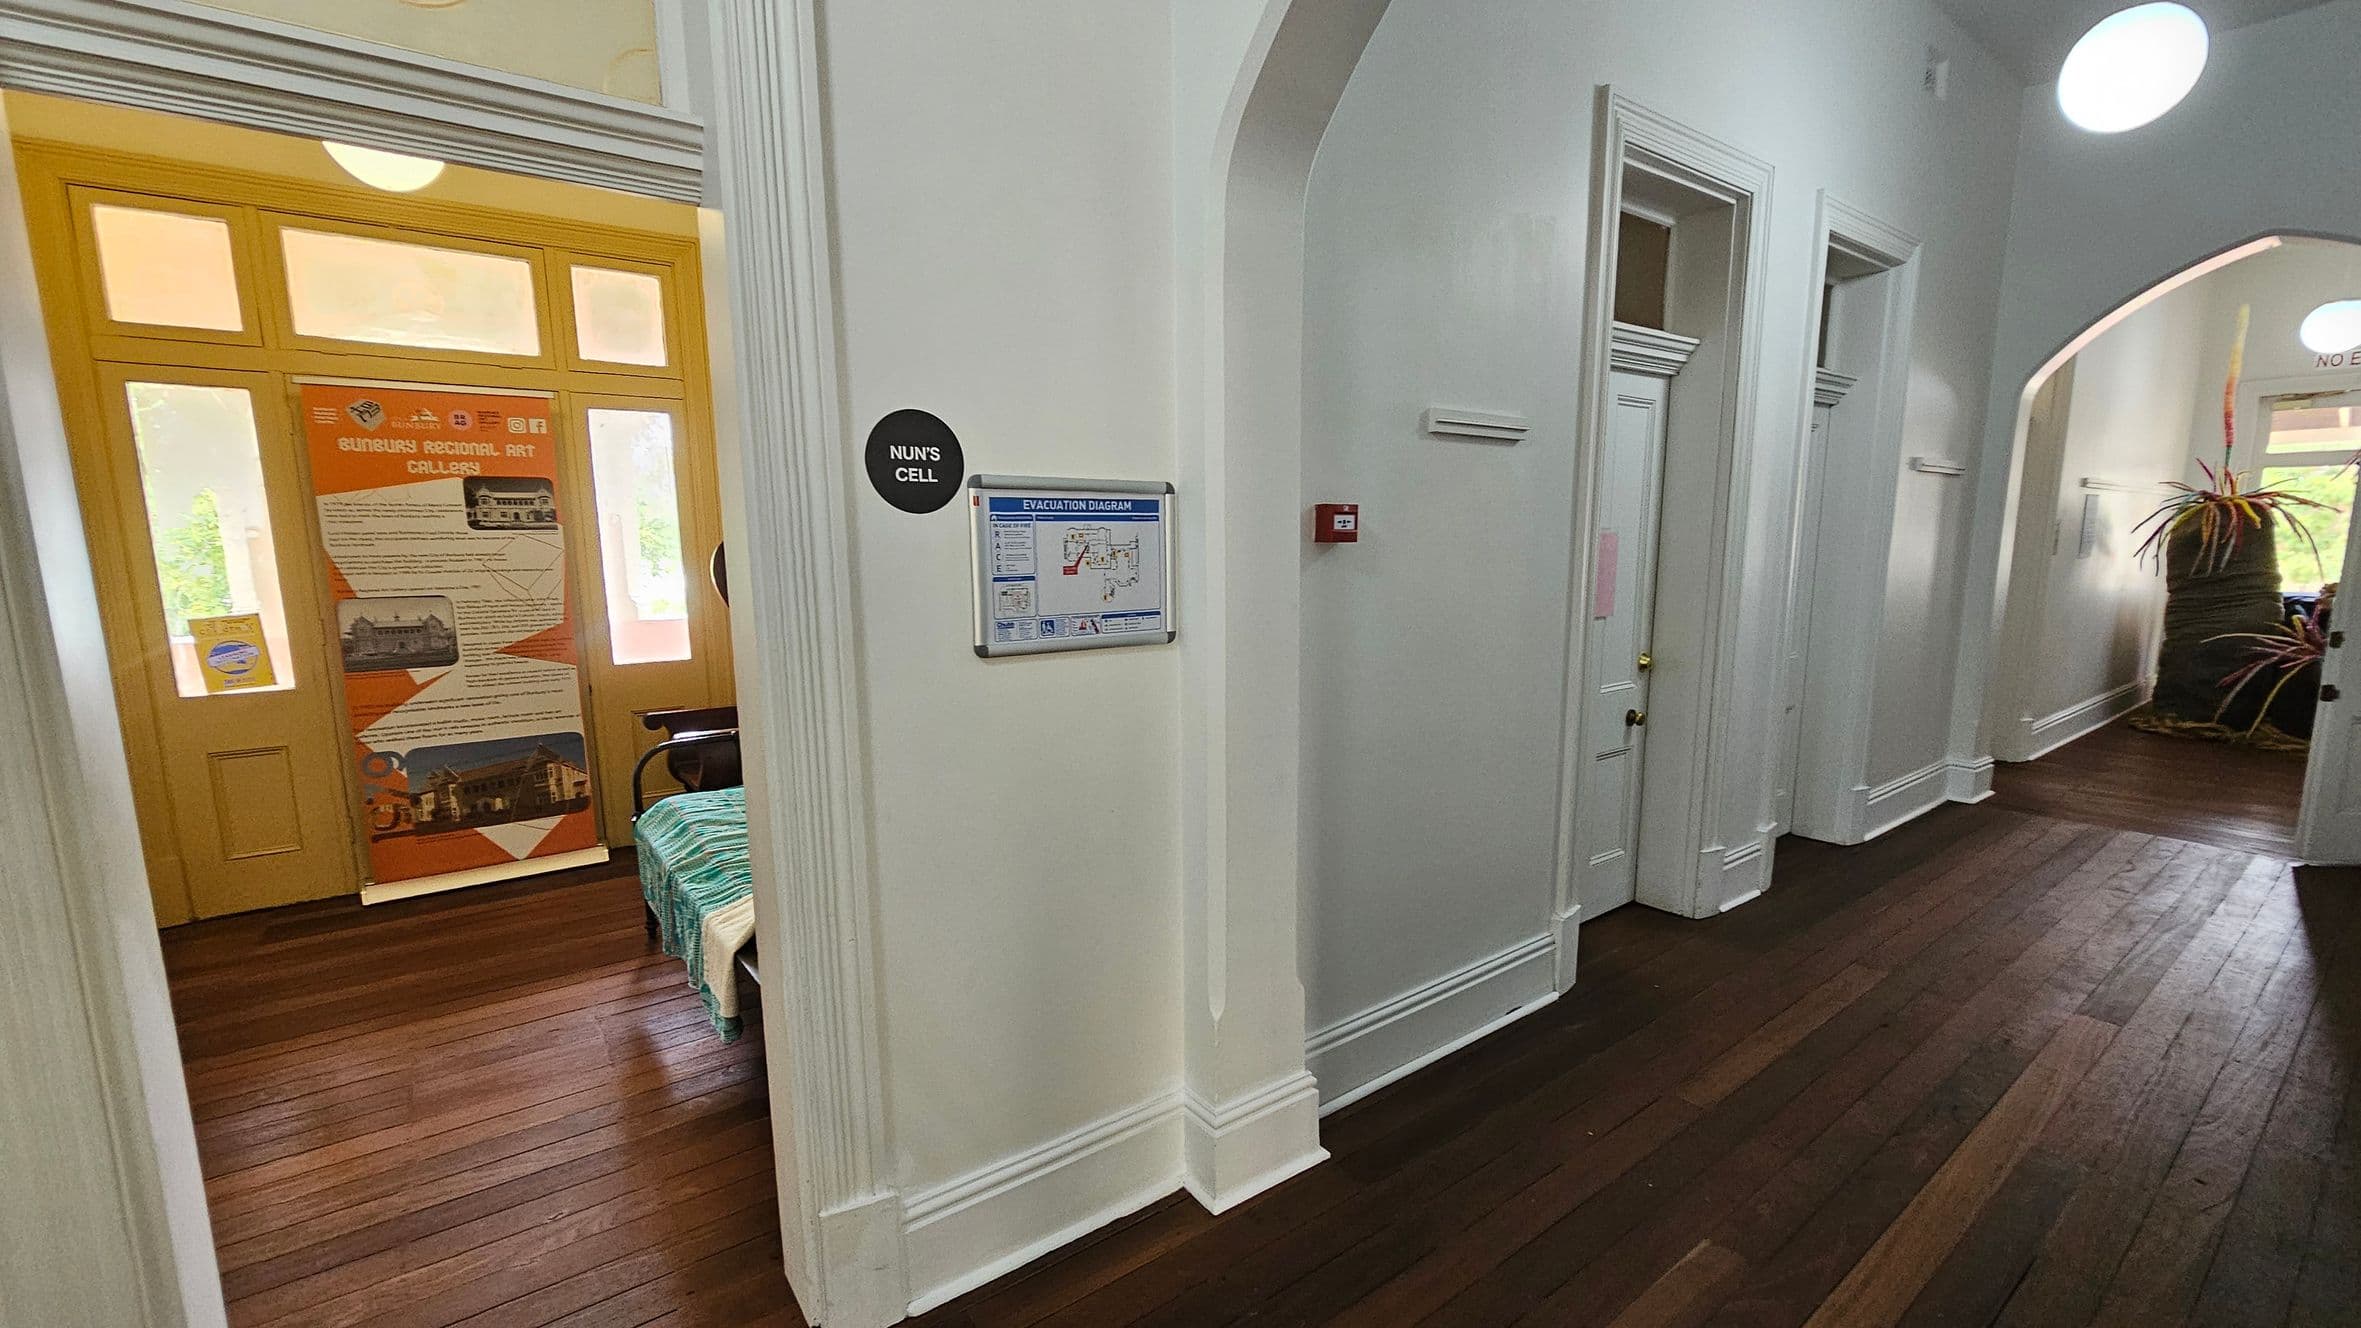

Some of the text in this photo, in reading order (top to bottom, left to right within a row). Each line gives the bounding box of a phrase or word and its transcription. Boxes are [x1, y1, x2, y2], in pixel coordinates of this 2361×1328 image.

[2315, 353, 2344, 368] NO
[338, 437, 417, 453] BUNBURY
[505, 443, 536, 458] ART
[889, 445, 941, 462] NUN'S
[895, 467, 938, 482] CELL
[1023, 499, 1132, 512] EVACUATION DIAGRAM
[996, 553, 1001, 561] C
